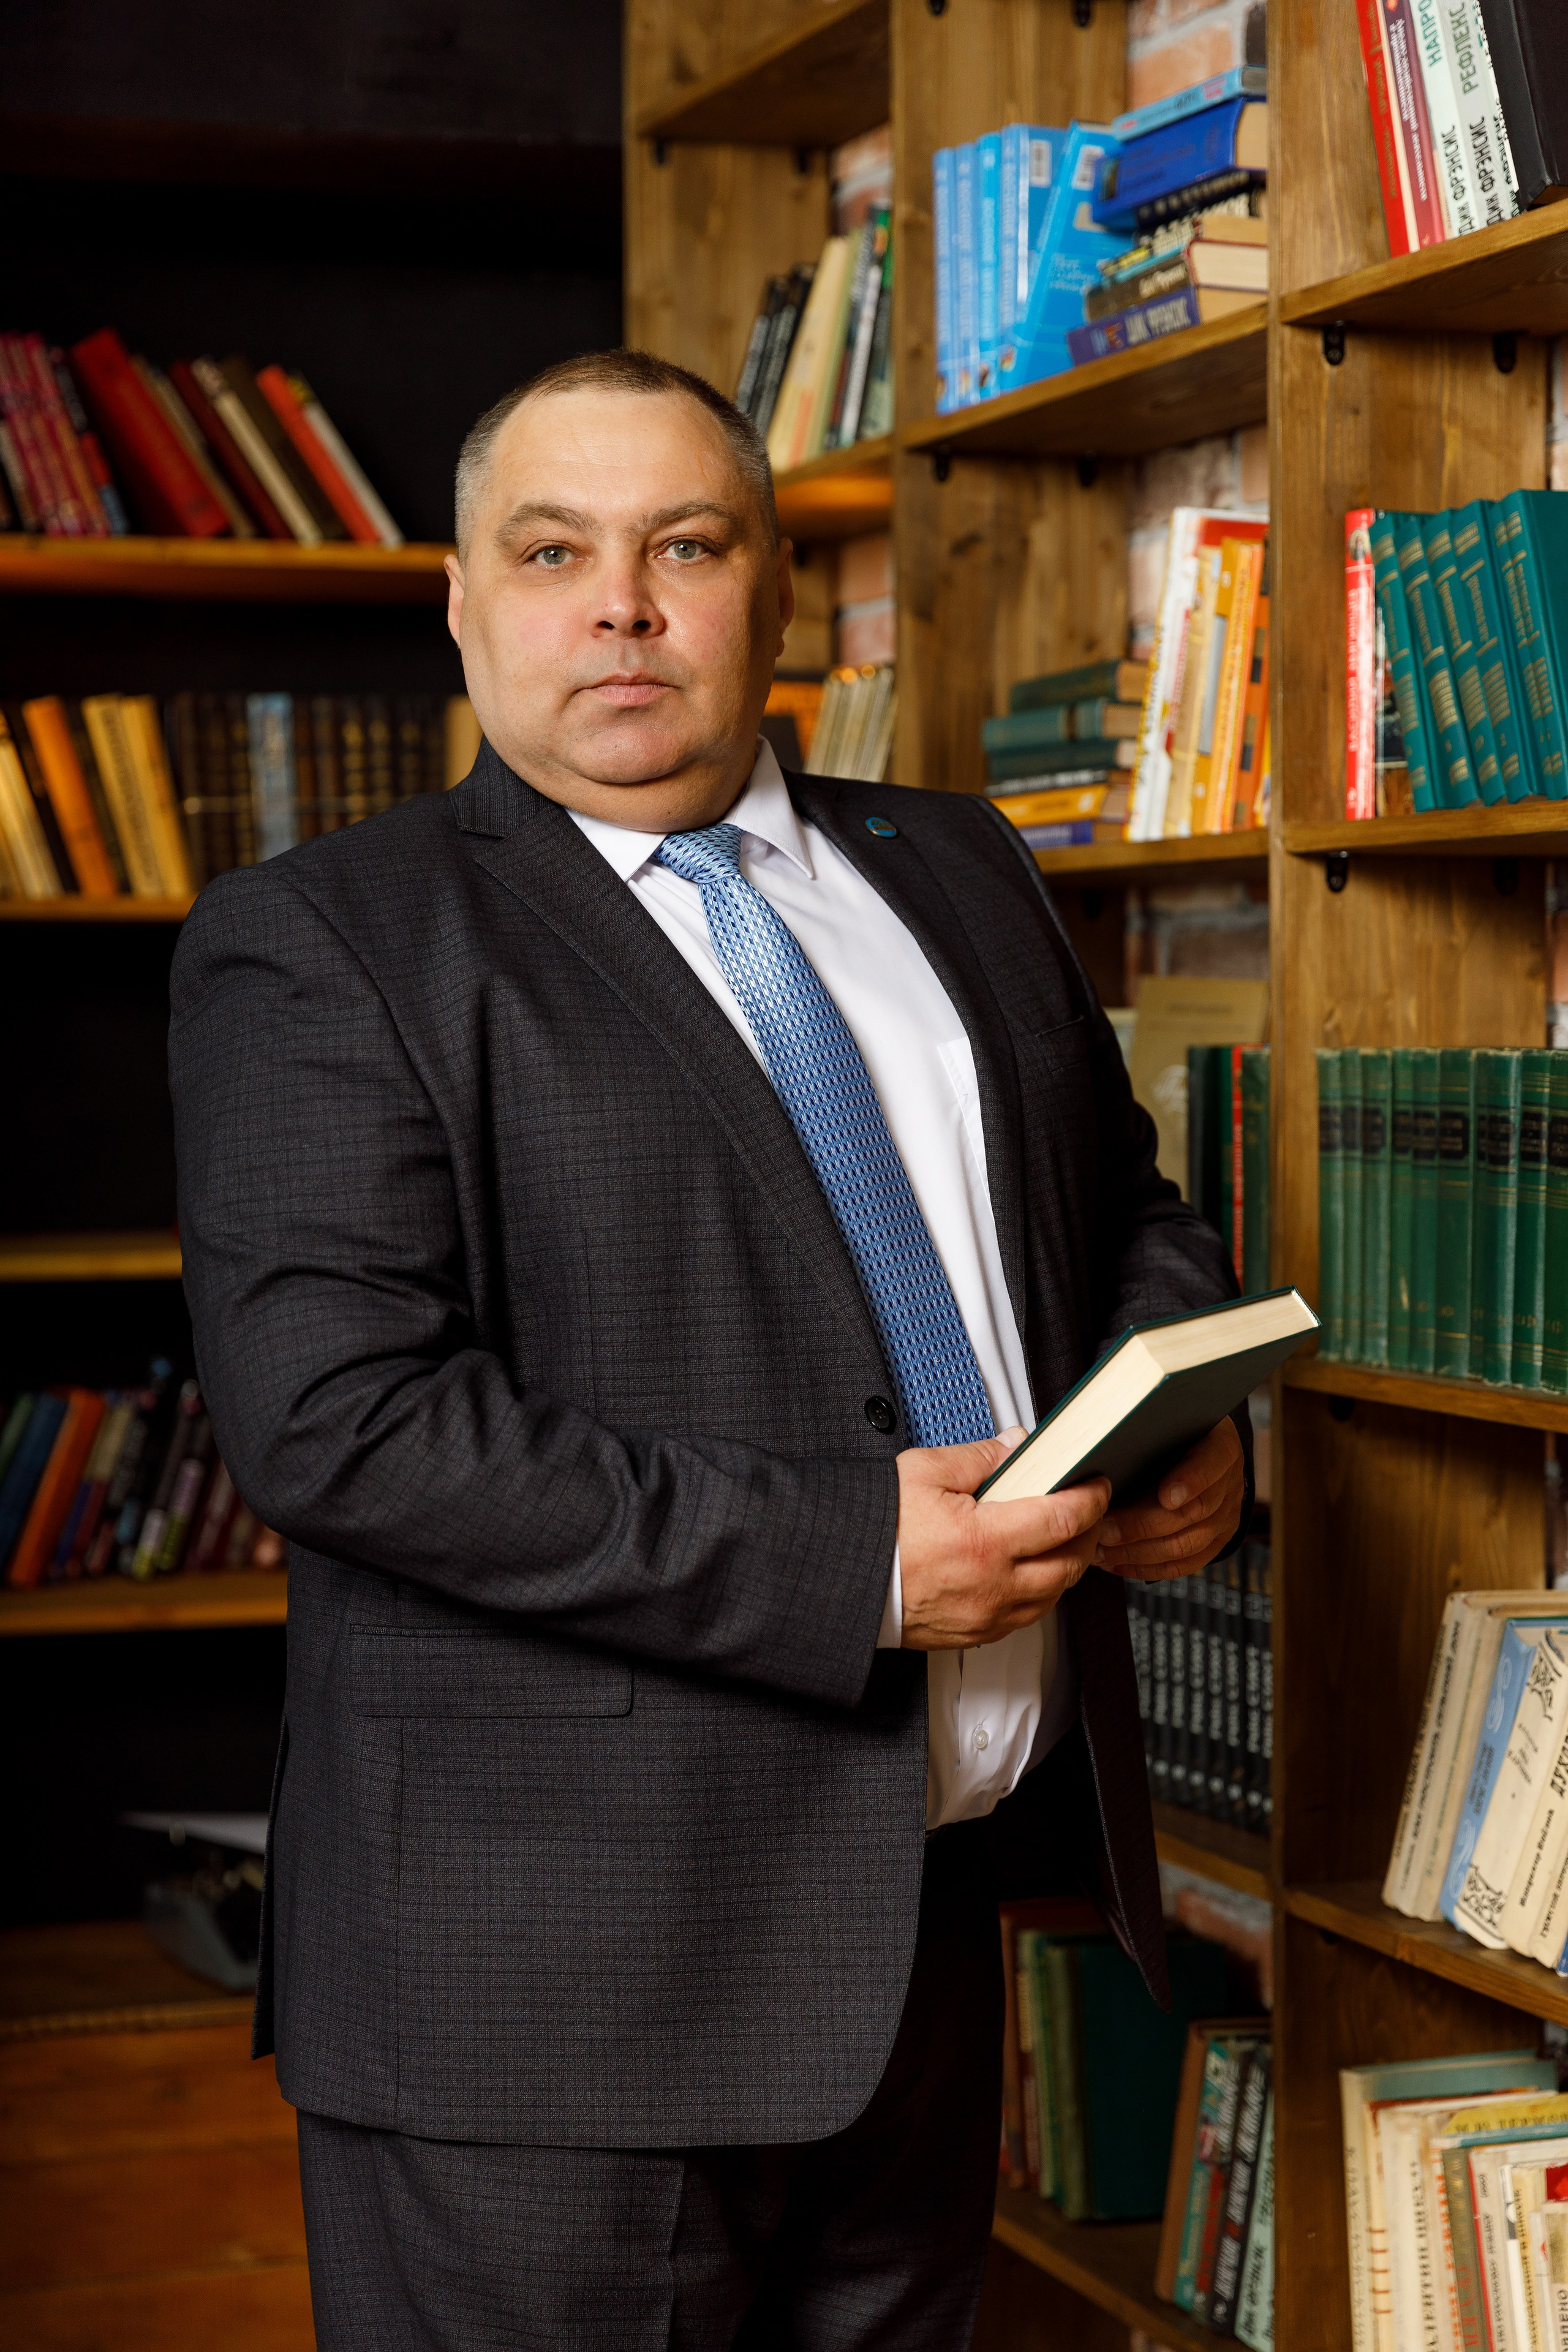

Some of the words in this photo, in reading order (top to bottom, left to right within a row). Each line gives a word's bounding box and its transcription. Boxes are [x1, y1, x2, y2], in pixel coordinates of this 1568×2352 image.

[1449, 2, 1479, 94] РЕФЛЕКС
[1441, 124, 1466, 201] ФРЭНСИС
[1469, 116, 1496, 193] ФРЭНСИС
